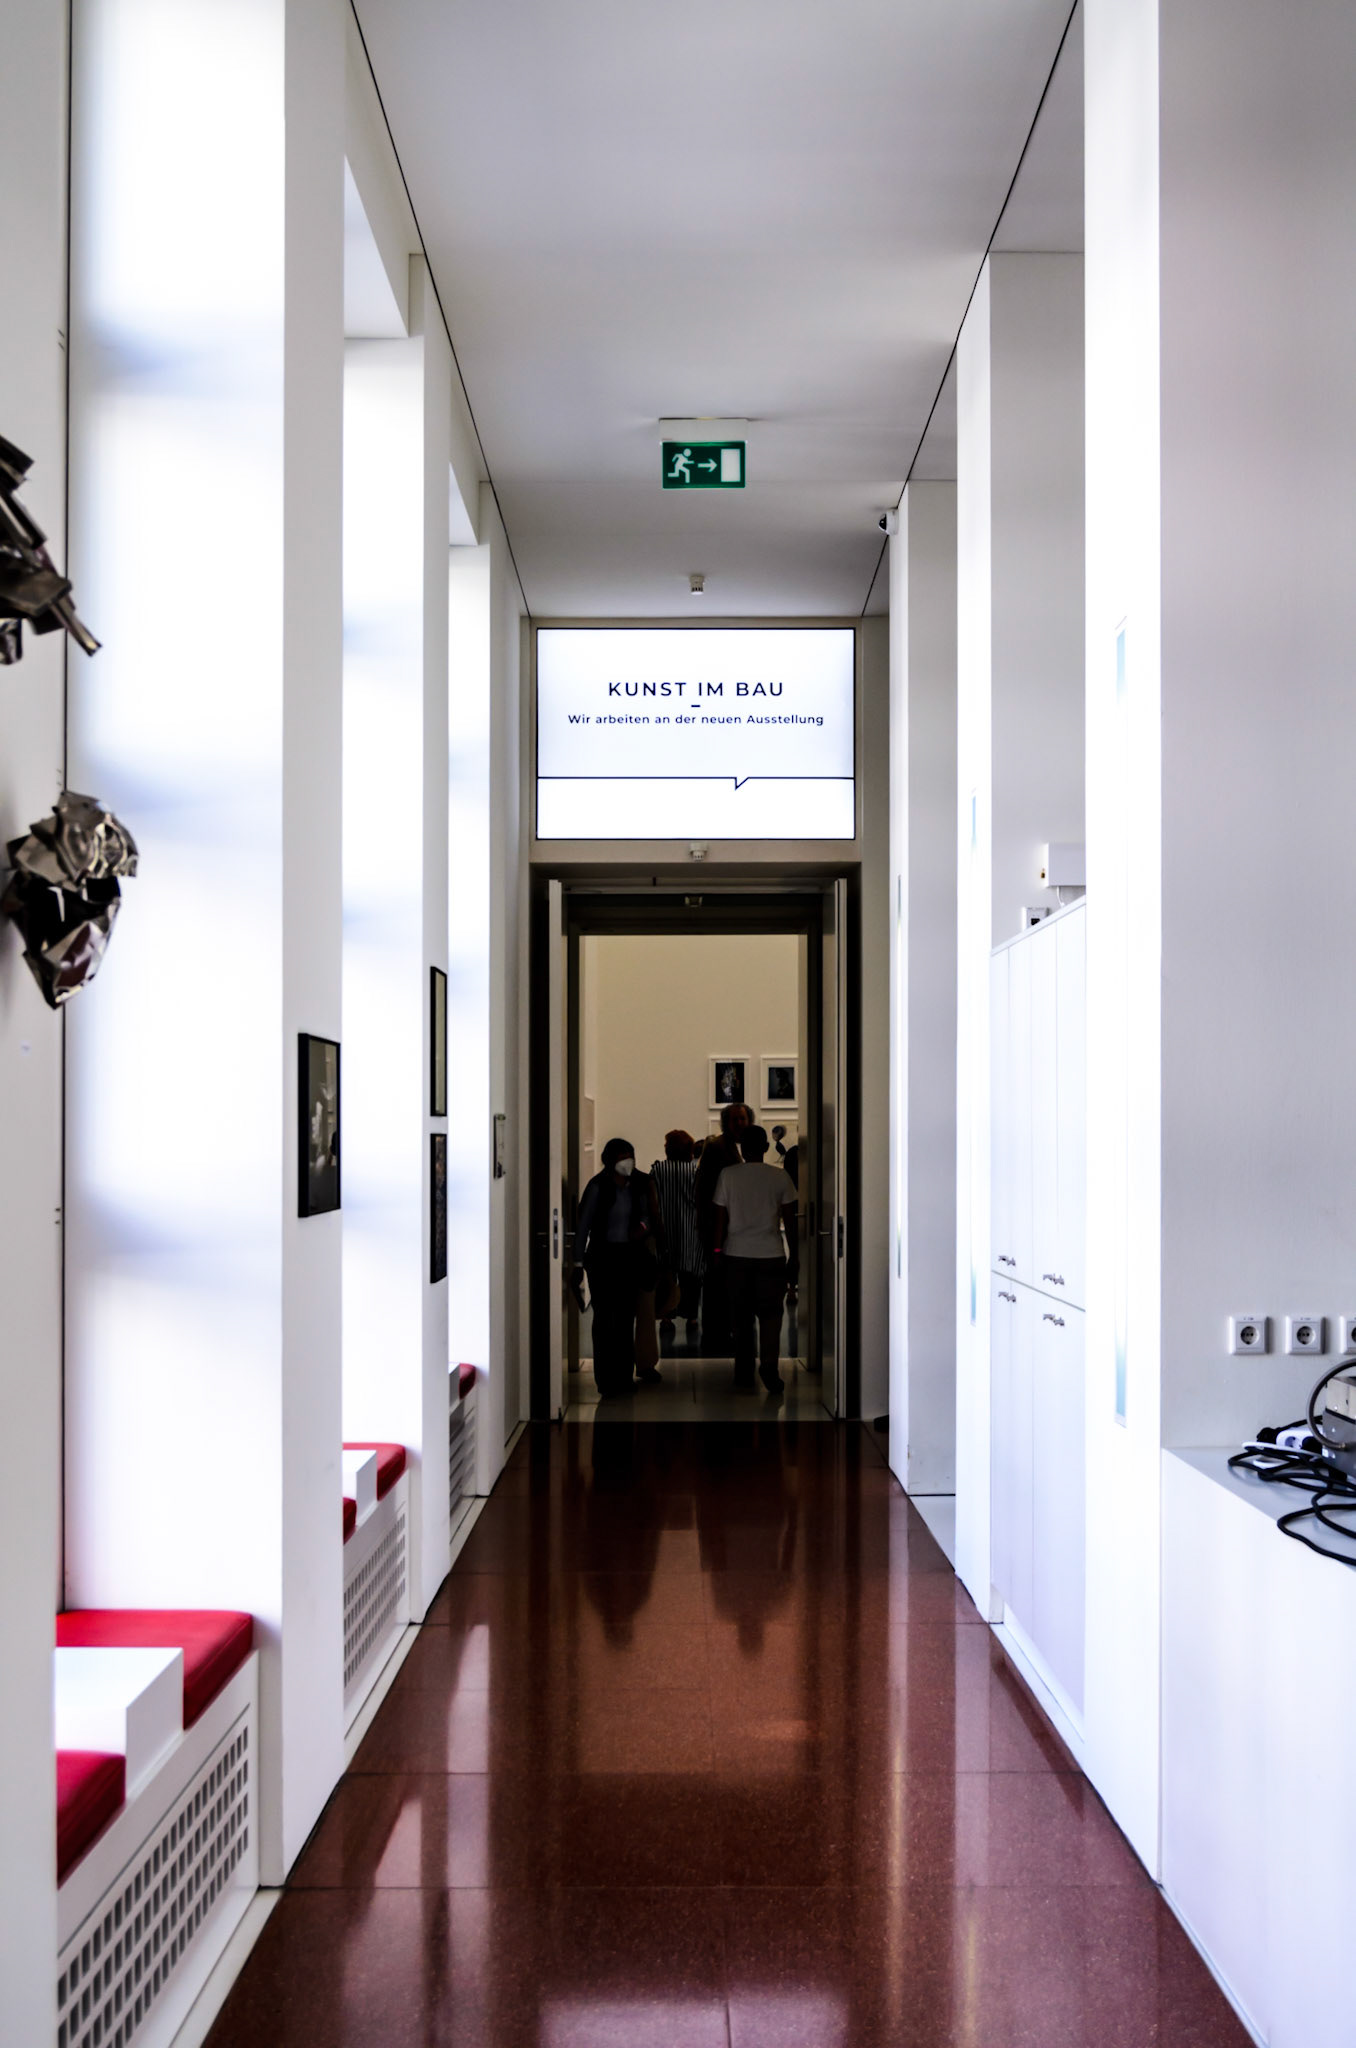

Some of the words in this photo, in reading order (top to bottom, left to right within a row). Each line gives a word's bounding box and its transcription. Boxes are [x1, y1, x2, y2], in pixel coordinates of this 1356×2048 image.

[608, 681, 687, 697] KUNST
[698, 681, 724, 697] IM
[736, 681, 783, 697] BAU
[568, 714, 591, 724] Wir
[596, 714, 650, 724] arbeiten
[655, 716, 671, 724] an
[675, 714, 697, 724] der
[701, 716, 742, 724] neuen
[746, 714, 824, 727] Ausstellung
